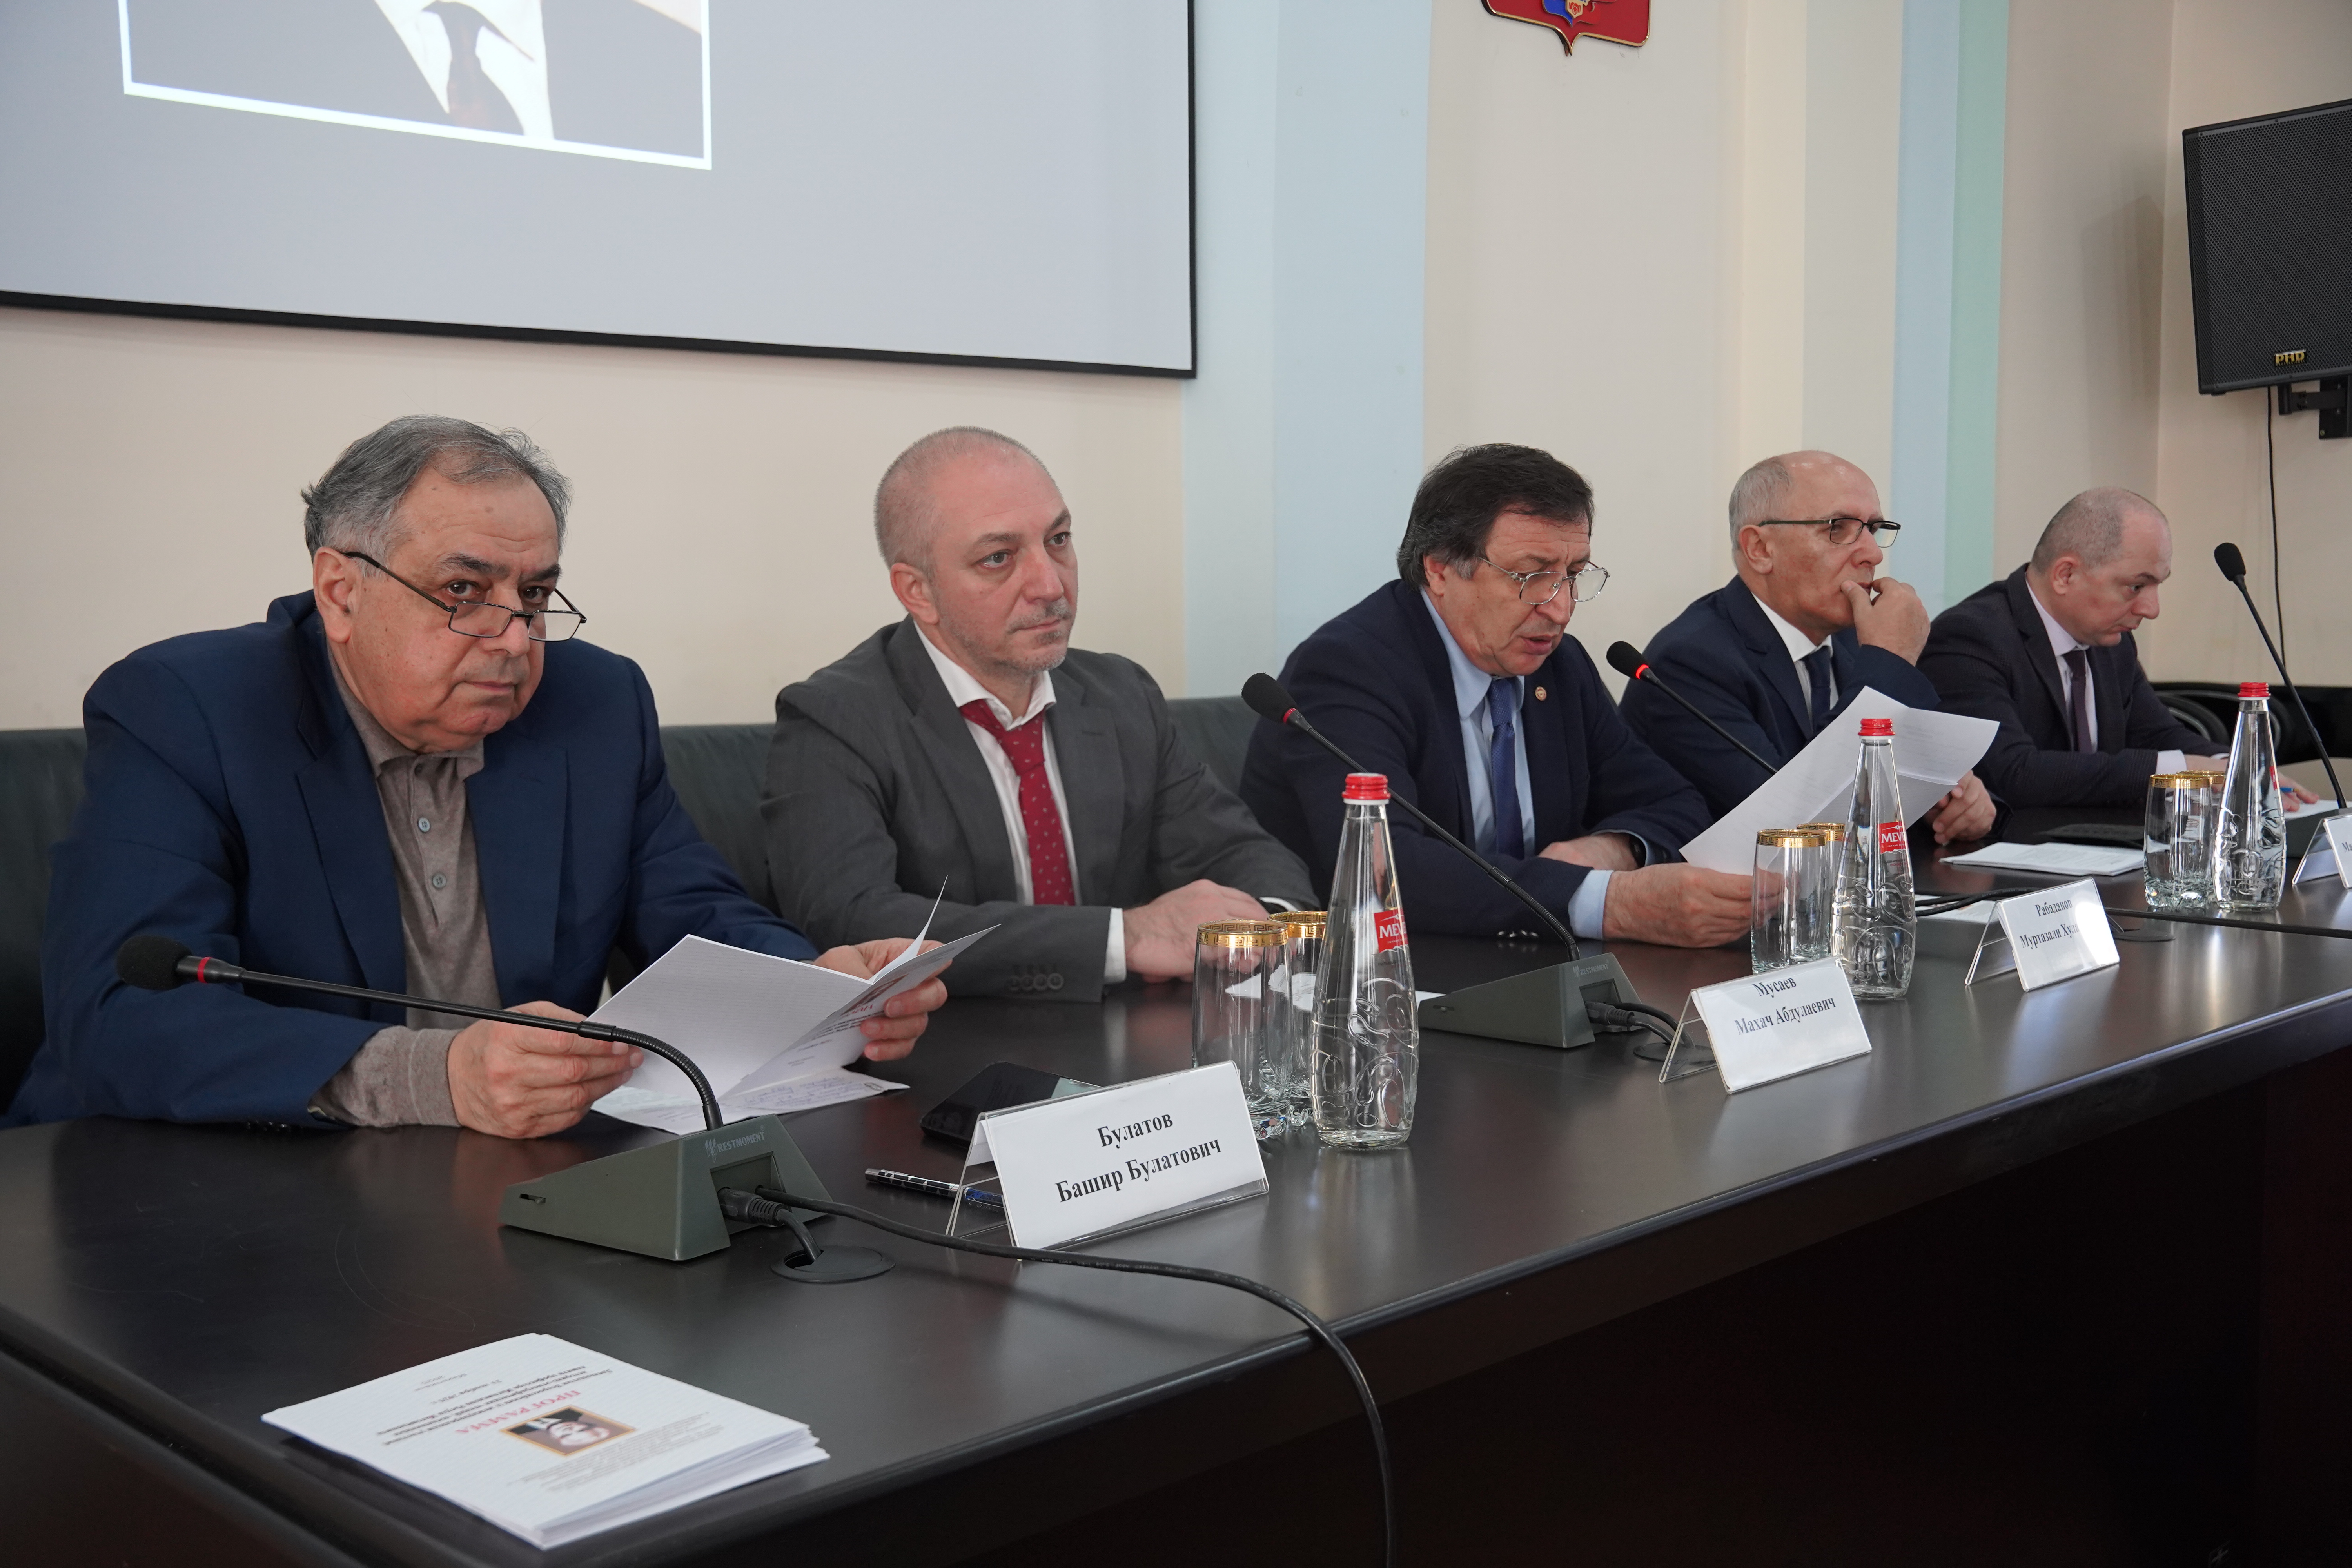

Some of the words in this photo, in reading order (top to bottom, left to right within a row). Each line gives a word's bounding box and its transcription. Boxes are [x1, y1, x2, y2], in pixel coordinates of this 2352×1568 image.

[2035, 898, 2073, 917] Рабаданов
[2020, 929, 2062, 950] Муртазали
[1752, 977, 1797, 998] Мусаев
[1734, 1015, 1774, 1035] Махач
[1775, 997, 1836, 1024] Абдулаевич
[717, 1131, 764, 1152] RESTMOMENT
[1096, 1114, 1173, 1149] Булатов
[1055, 1168, 1123, 1203] Башир
[1125, 1138, 1221, 1181] Булатович
[454, 1390, 583, 1434] ПРОГРАММА
